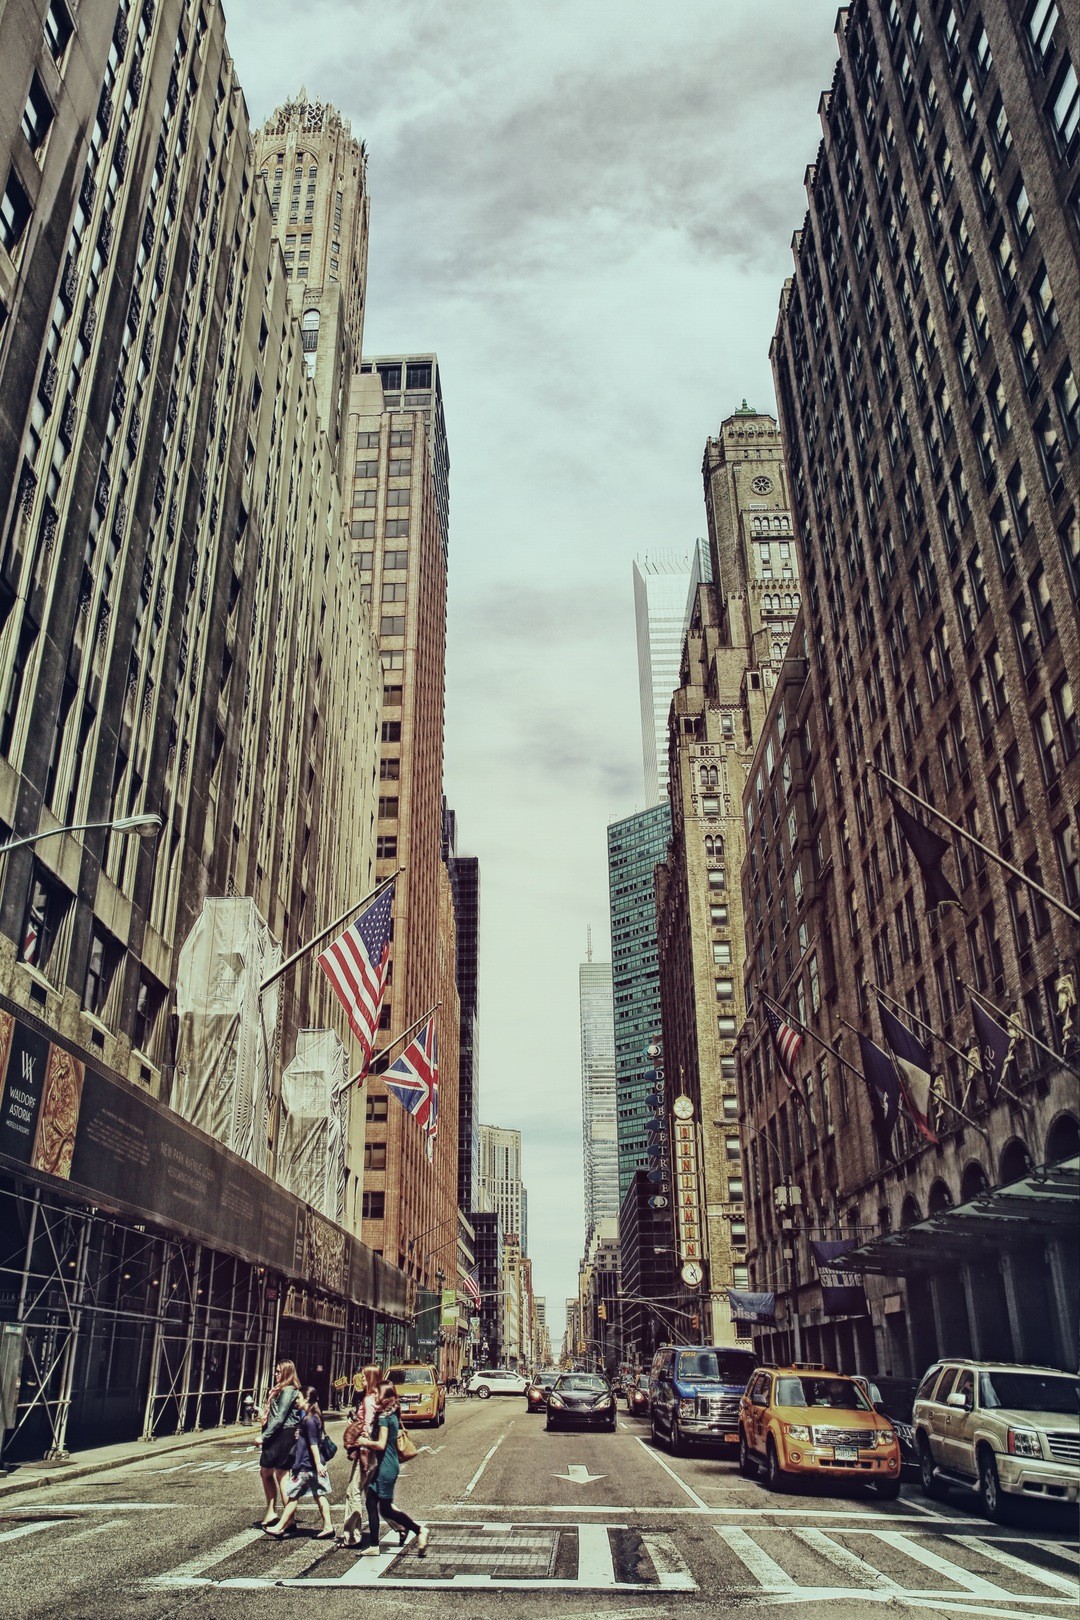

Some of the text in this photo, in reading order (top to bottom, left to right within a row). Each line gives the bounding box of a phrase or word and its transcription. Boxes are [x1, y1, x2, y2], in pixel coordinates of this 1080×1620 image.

[9, 1086, 37, 1109] WALDORF
[8, 1103, 32, 1123] ASTORIA
[655, 1070, 670, 1193] DOUBLETREE
[820, 1274, 862, 1287] BLUE
[730, 1307, 757, 1320] bliss
